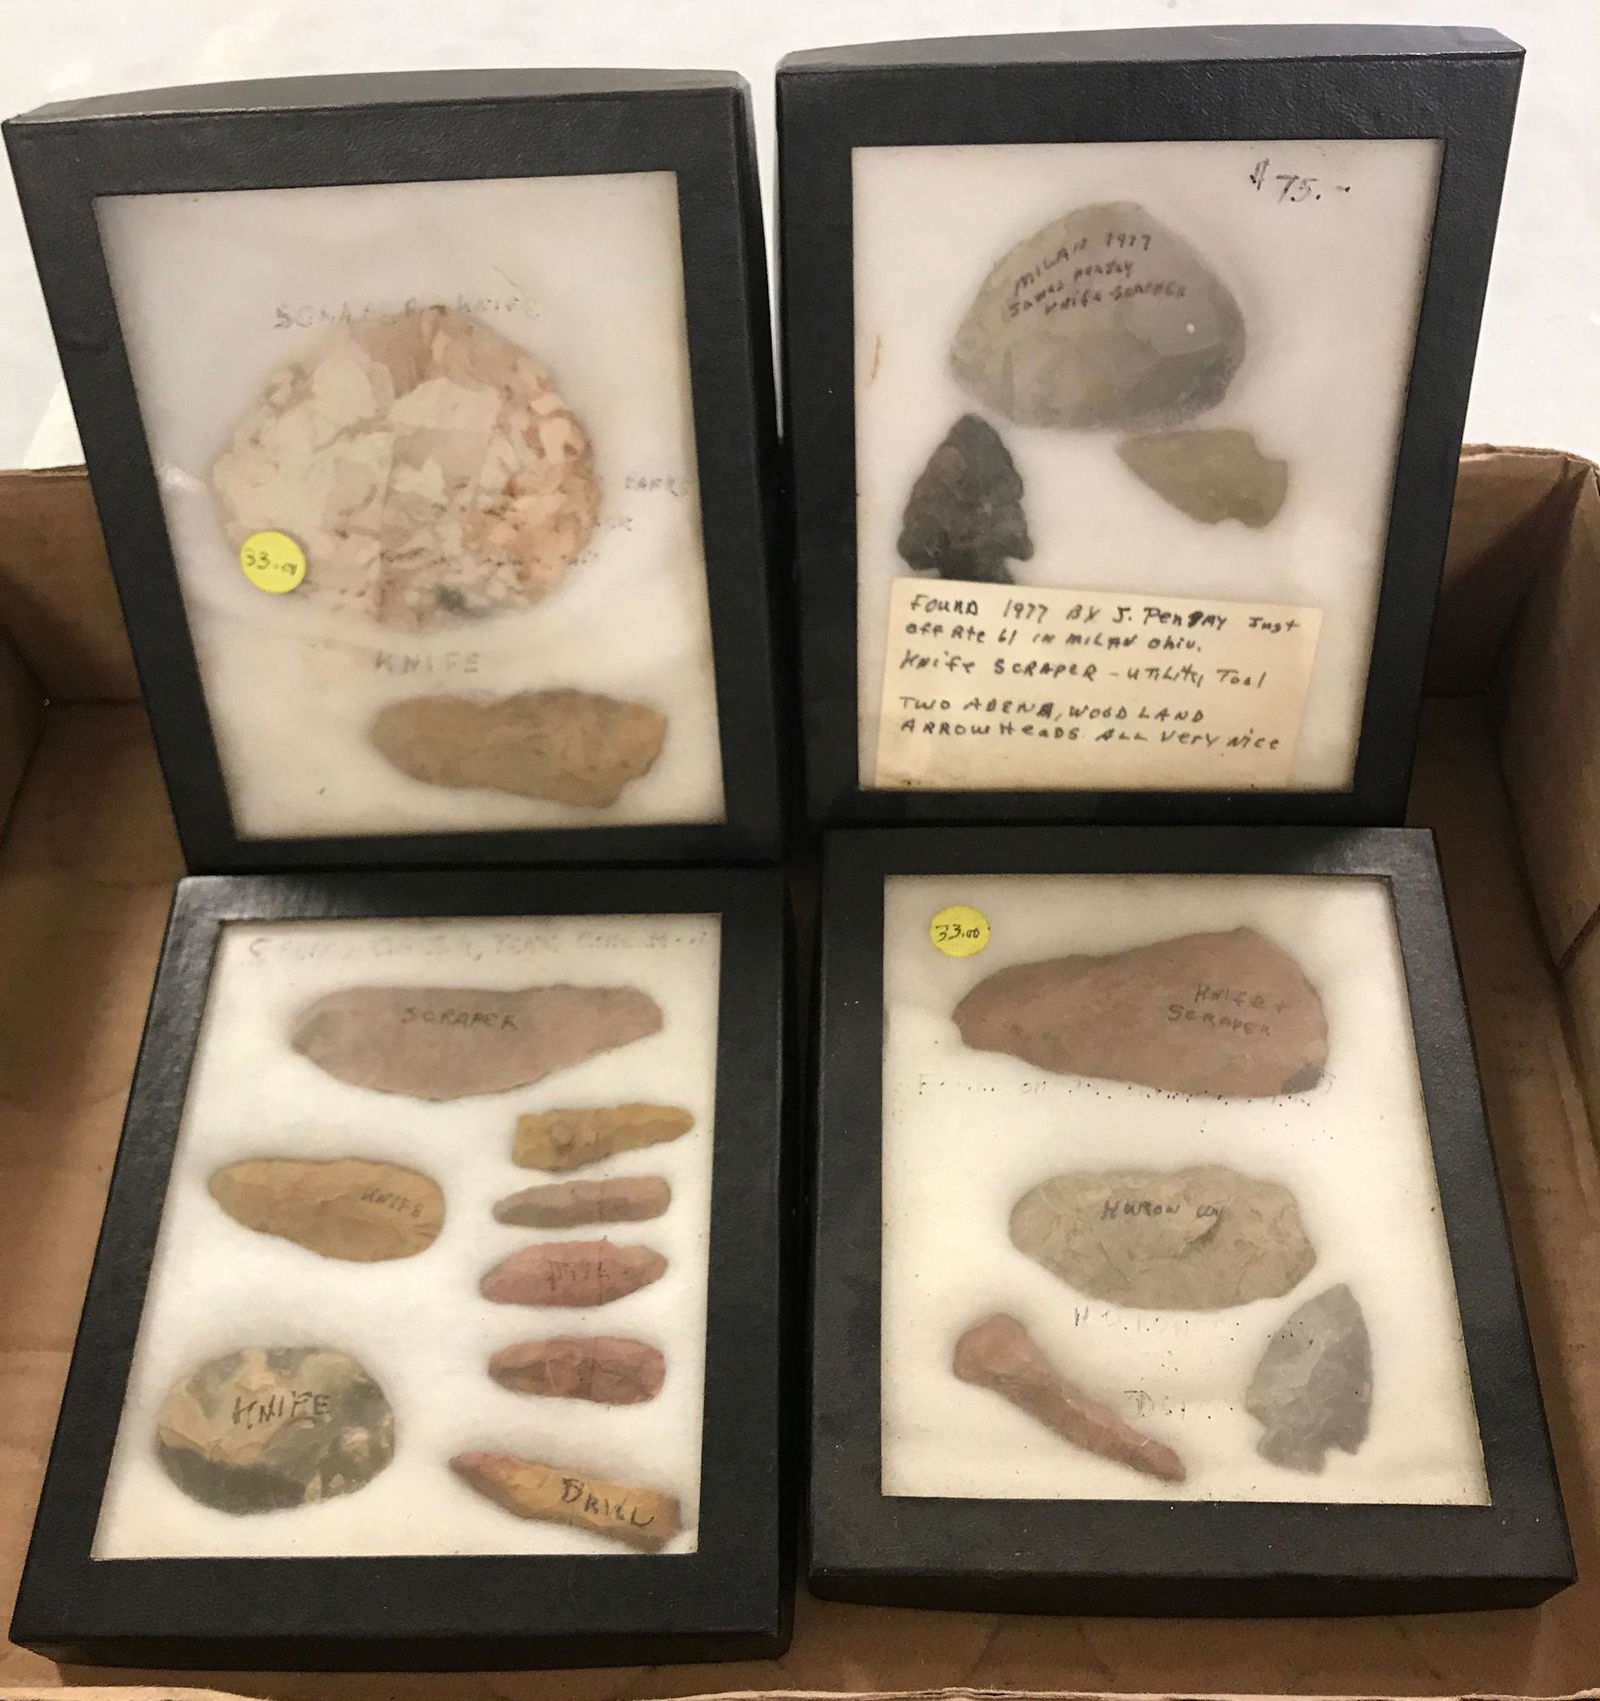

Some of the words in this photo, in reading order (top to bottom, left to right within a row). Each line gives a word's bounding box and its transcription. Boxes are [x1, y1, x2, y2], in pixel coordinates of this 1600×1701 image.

[1105, 232, 1152, 250] 1977
[1002, 598, 1049, 625] 1977
[997, 627, 1018, 646] 61
[373, 650, 481, 676] KNIFE
[898, 695, 951, 711] TWO
[935, 923, 981, 943] 33.00
[231, 1389, 331, 1430] KNIFE
